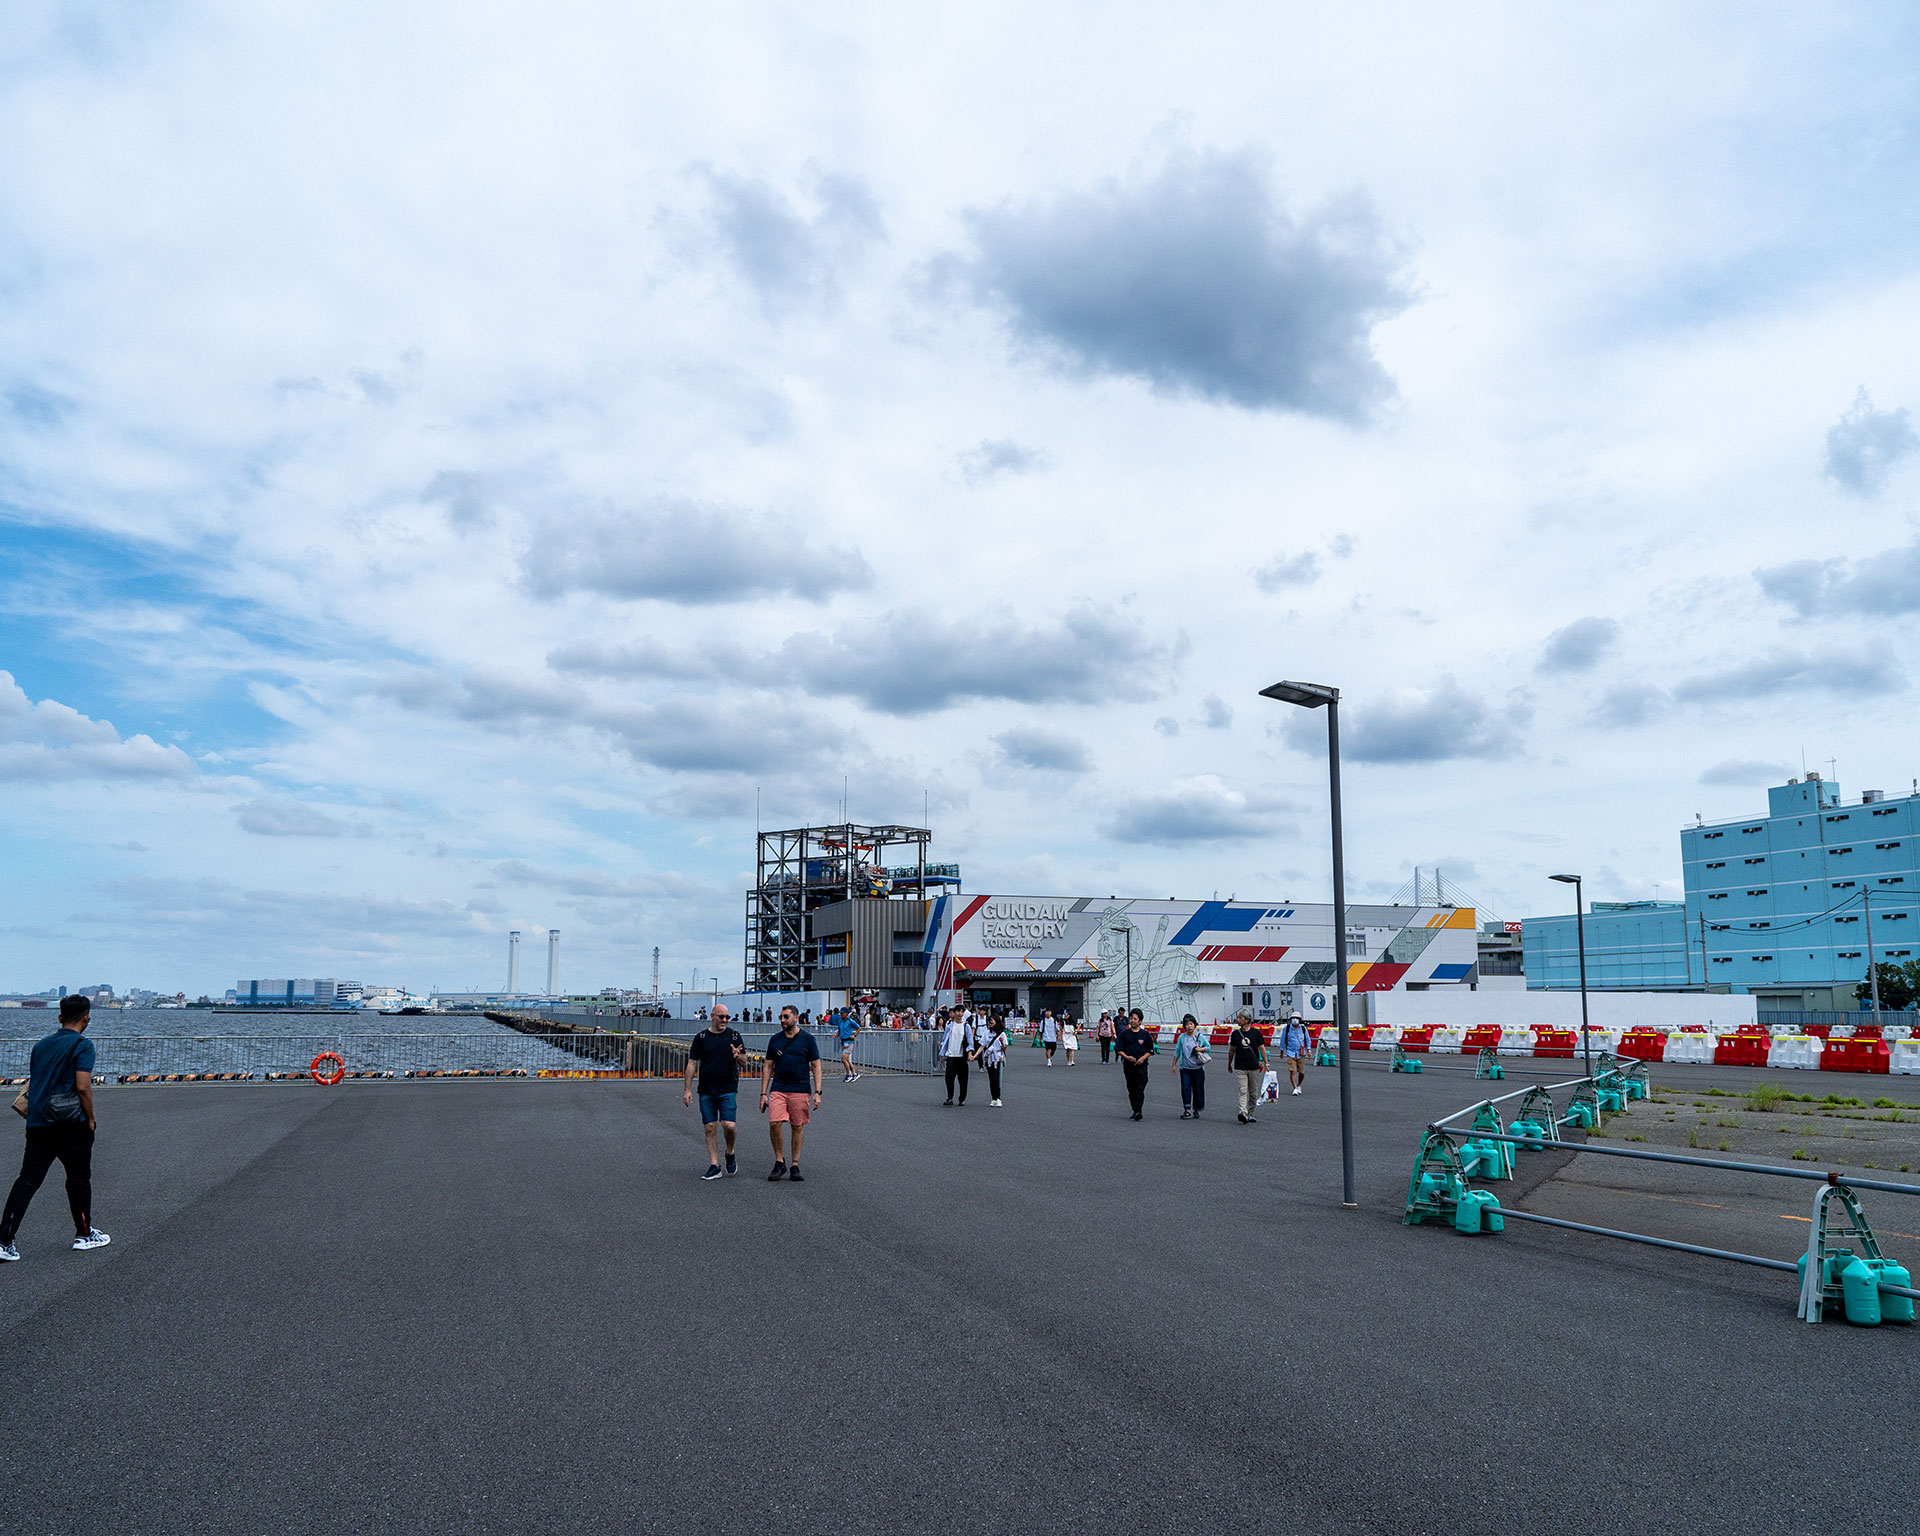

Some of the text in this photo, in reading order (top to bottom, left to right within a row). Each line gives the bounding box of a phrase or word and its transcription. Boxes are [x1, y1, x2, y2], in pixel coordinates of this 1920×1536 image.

[982, 903, 1068, 921] GUNDAM
[982, 922, 1068, 939] FACTORY
[982, 938, 1042, 949] YOKOHAMA
